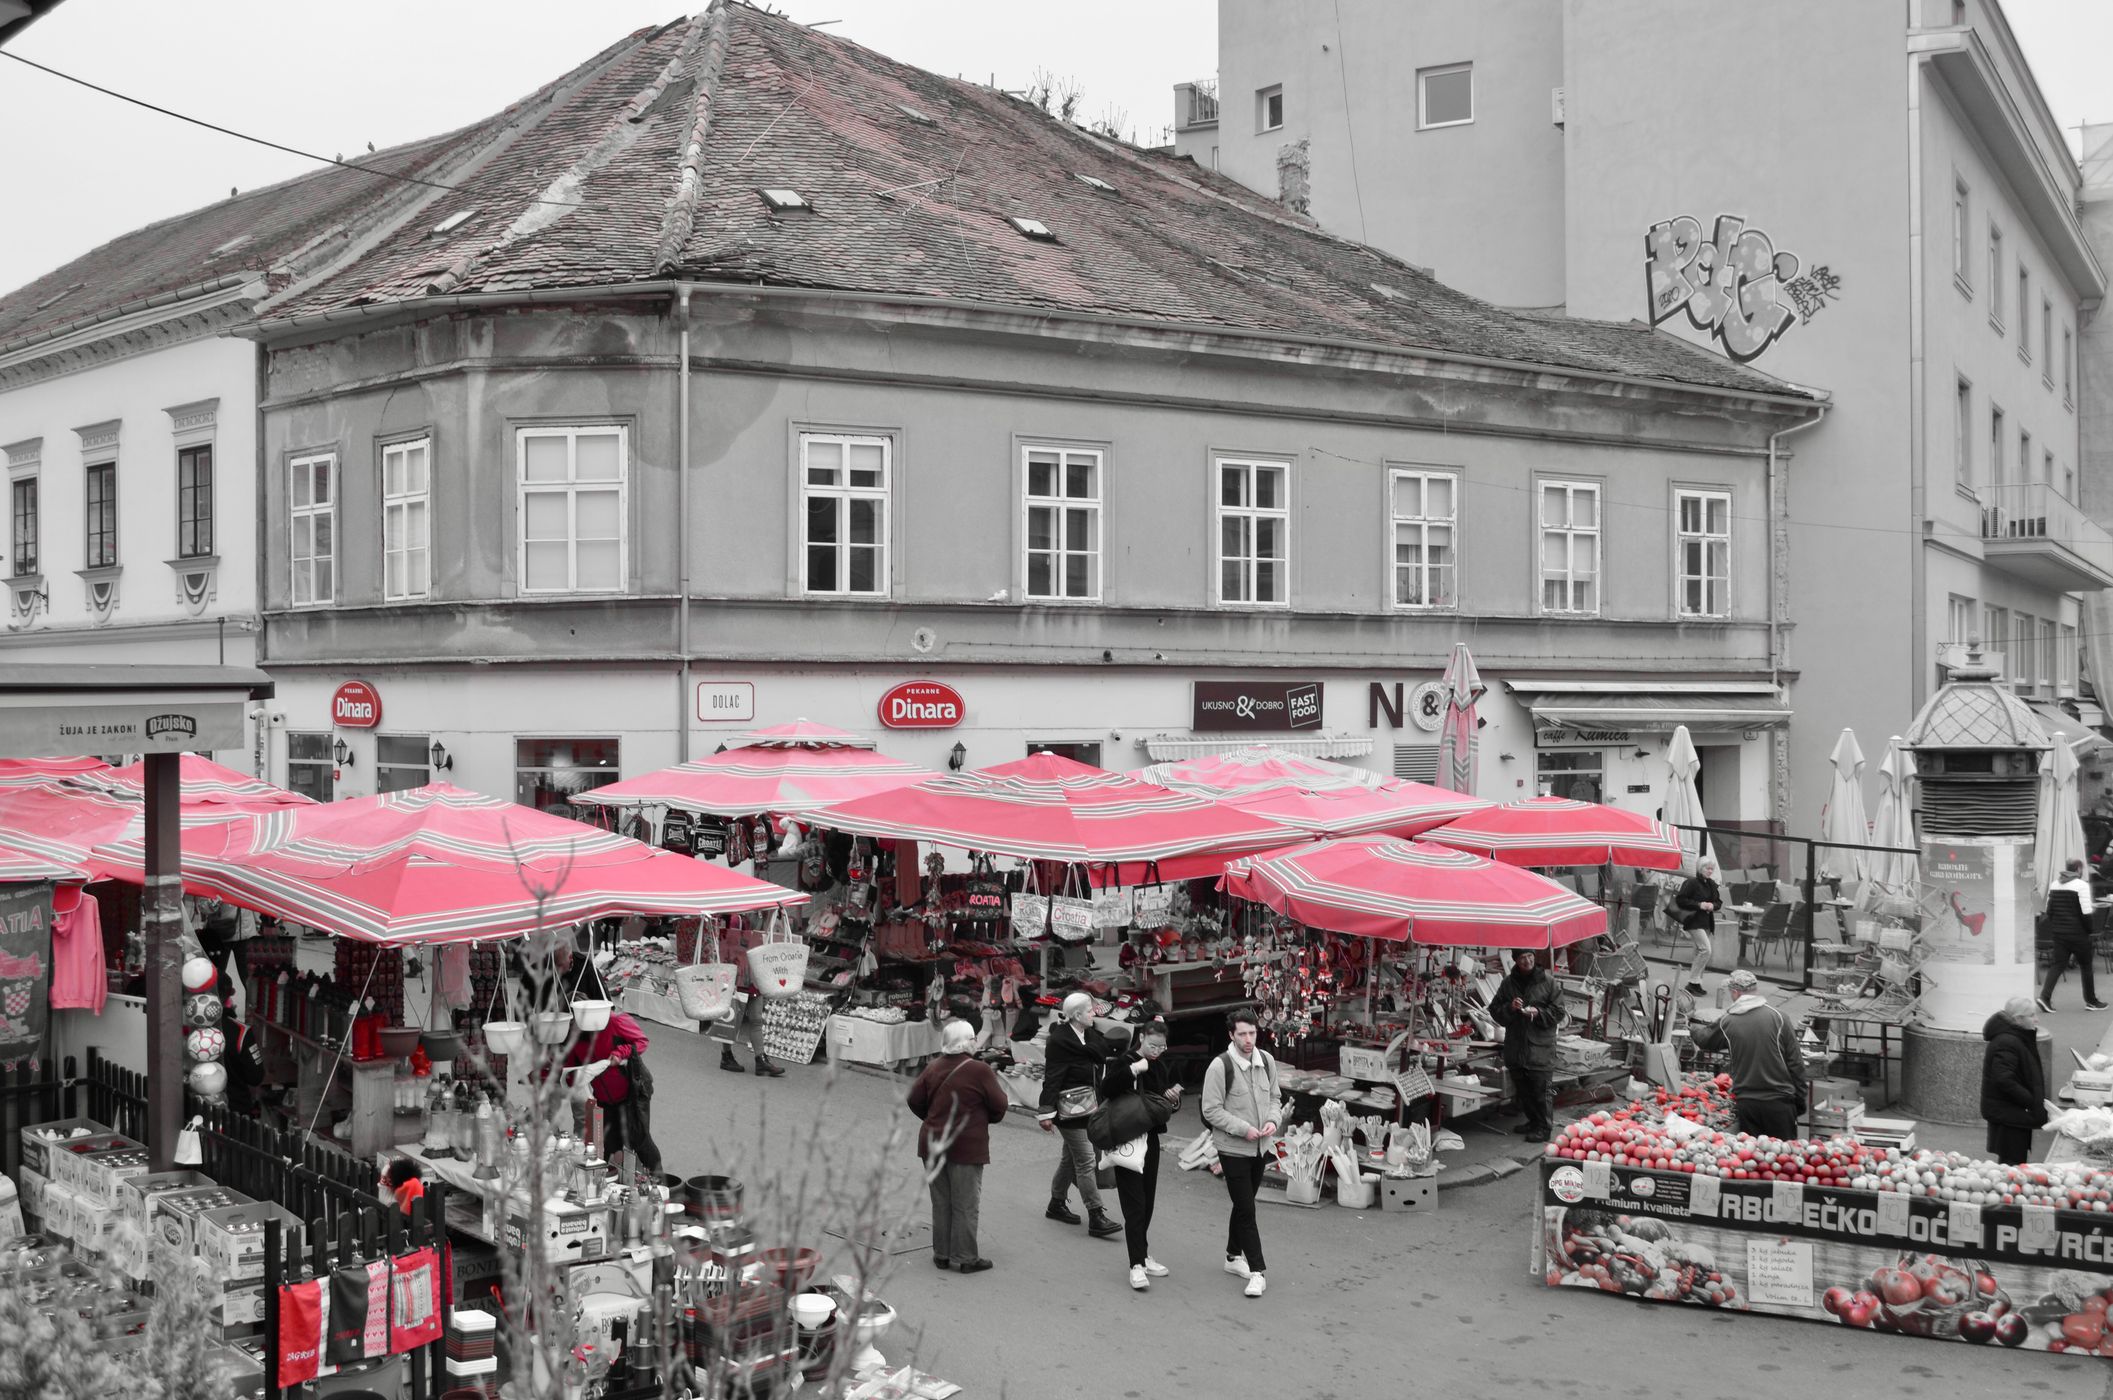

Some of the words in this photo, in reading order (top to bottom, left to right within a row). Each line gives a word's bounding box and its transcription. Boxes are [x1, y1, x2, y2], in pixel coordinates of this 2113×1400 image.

[337, 697, 372, 718] Dinara
[712, 694, 740, 709] DOLAC
[892, 698, 956, 719] Dinara
[1202, 701, 1235, 710] UKUSNO
[1236, 695, 1256, 720] &
[1256, 701, 1284, 710] DOBRO
[1290, 693, 1316, 709] FAST
[1370, 682, 1403, 728] N
[1422, 694, 1439, 716] &
[1292, 705, 1317, 719] FOOD
[60, 724, 83, 736] ŽUJA
[87, 726, 97, 734] JE
[102, 724, 137, 734] ZAKON!
[150, 715, 193, 733] Ožujsko
[1053, 907, 1087, 925] Croatia
[762, 955, 779, 963] From
